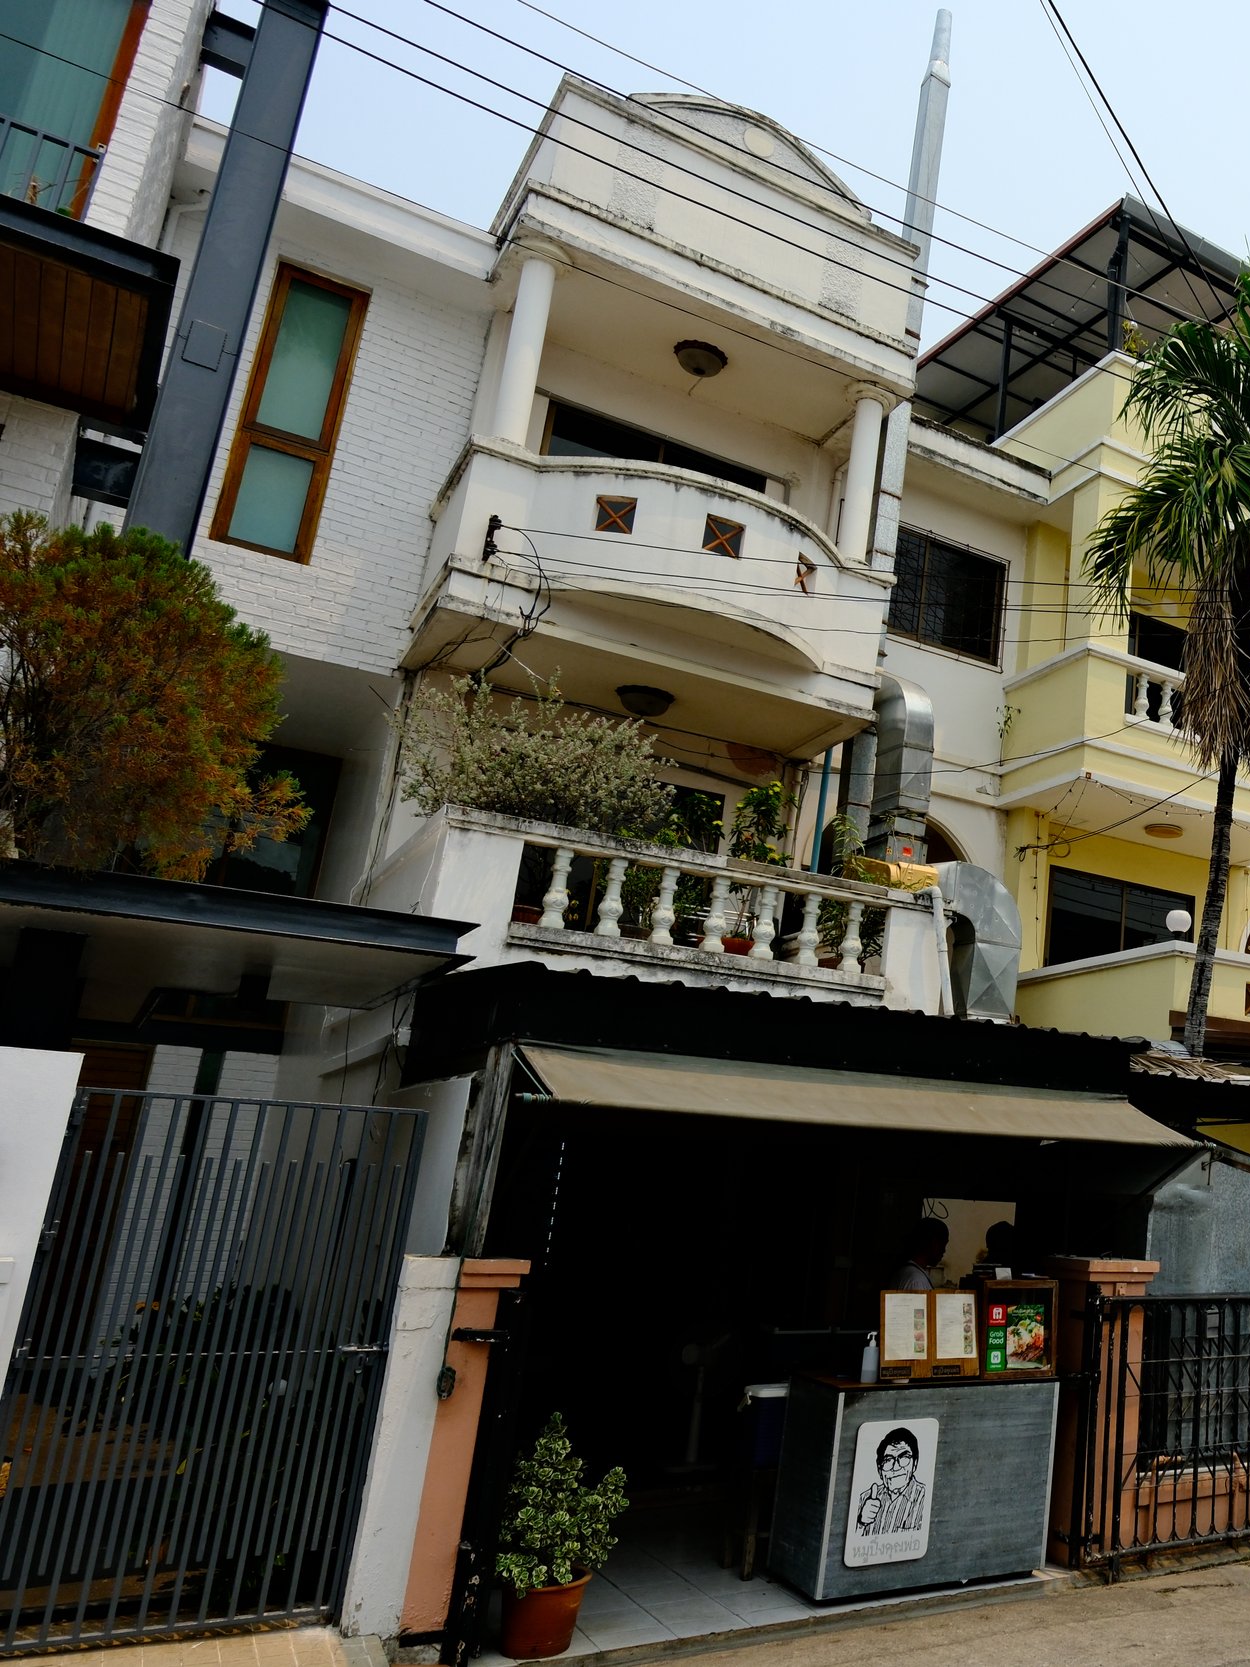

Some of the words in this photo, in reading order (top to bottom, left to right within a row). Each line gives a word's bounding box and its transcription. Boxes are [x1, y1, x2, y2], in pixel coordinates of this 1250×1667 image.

[852, 1536, 921, 1563] หมูปิ้งคุณพ่อ
